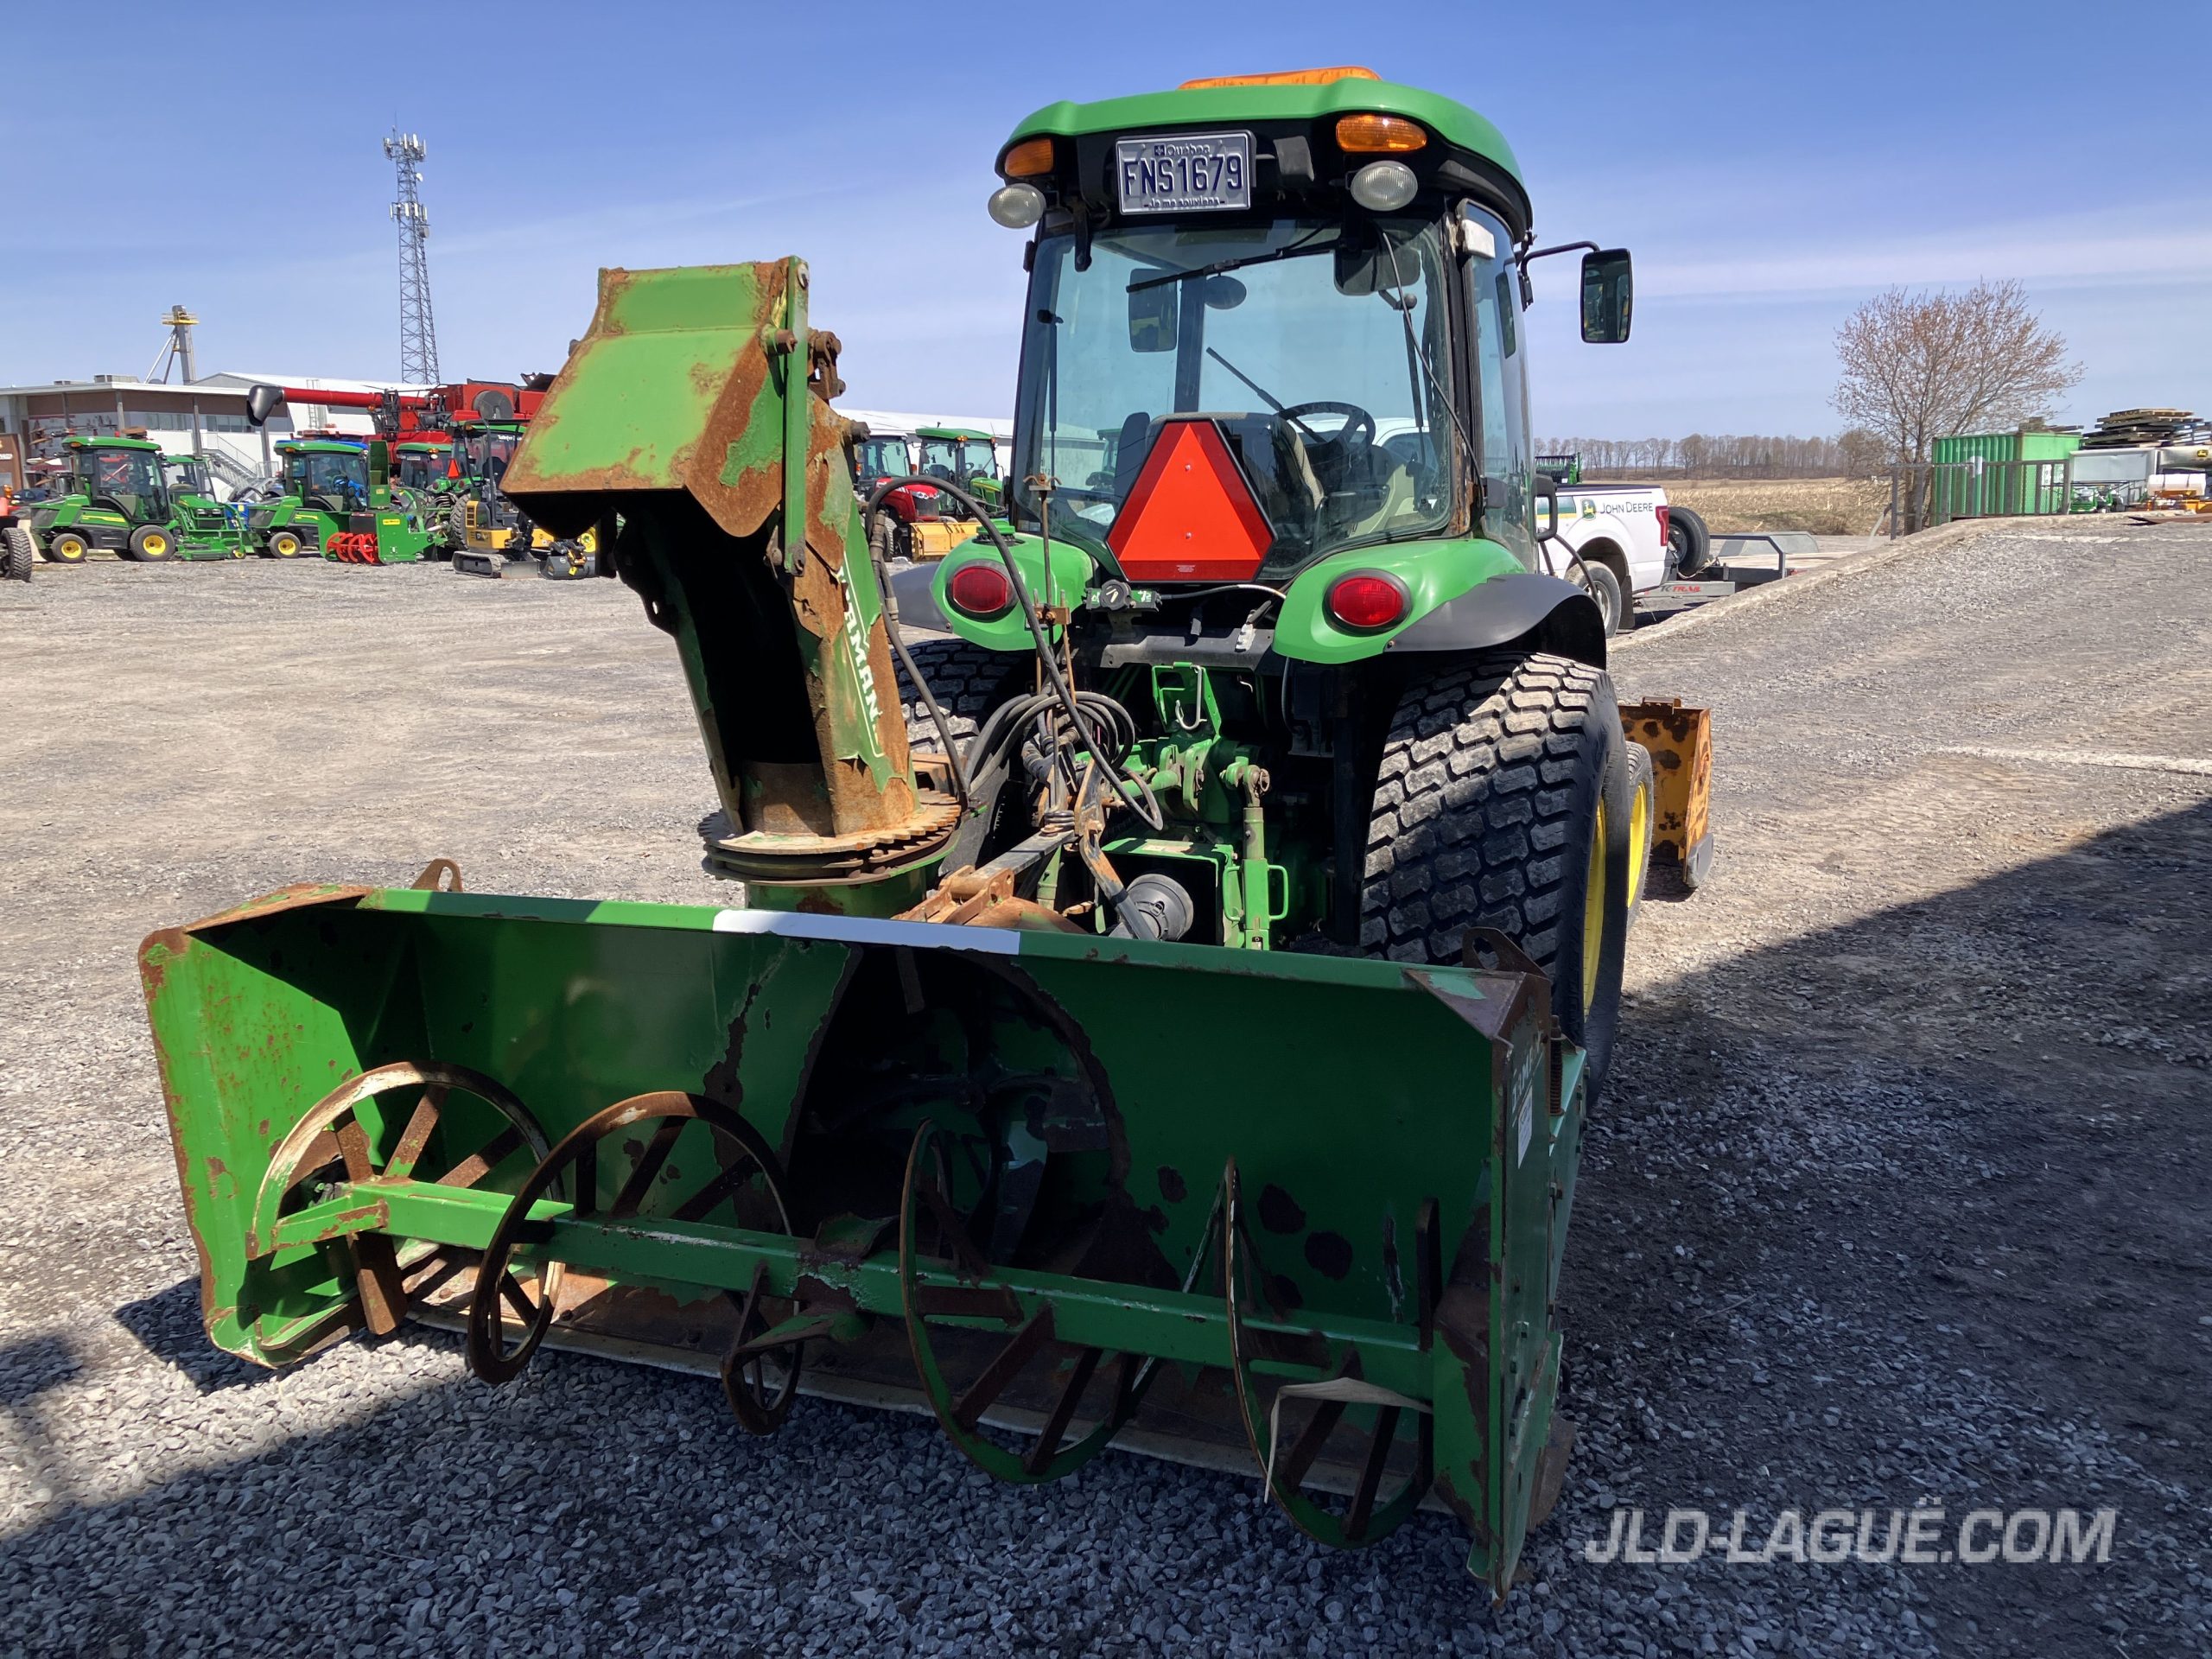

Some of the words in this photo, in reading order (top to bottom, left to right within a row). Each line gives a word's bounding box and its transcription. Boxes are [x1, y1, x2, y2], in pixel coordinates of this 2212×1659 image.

[1166, 143, 1211, 156] Québec
[1122, 153, 1243, 195] FNS1679
[1601, 504, 1624, 514] JOHN
[1625, 501, 1654, 512] DEERE
